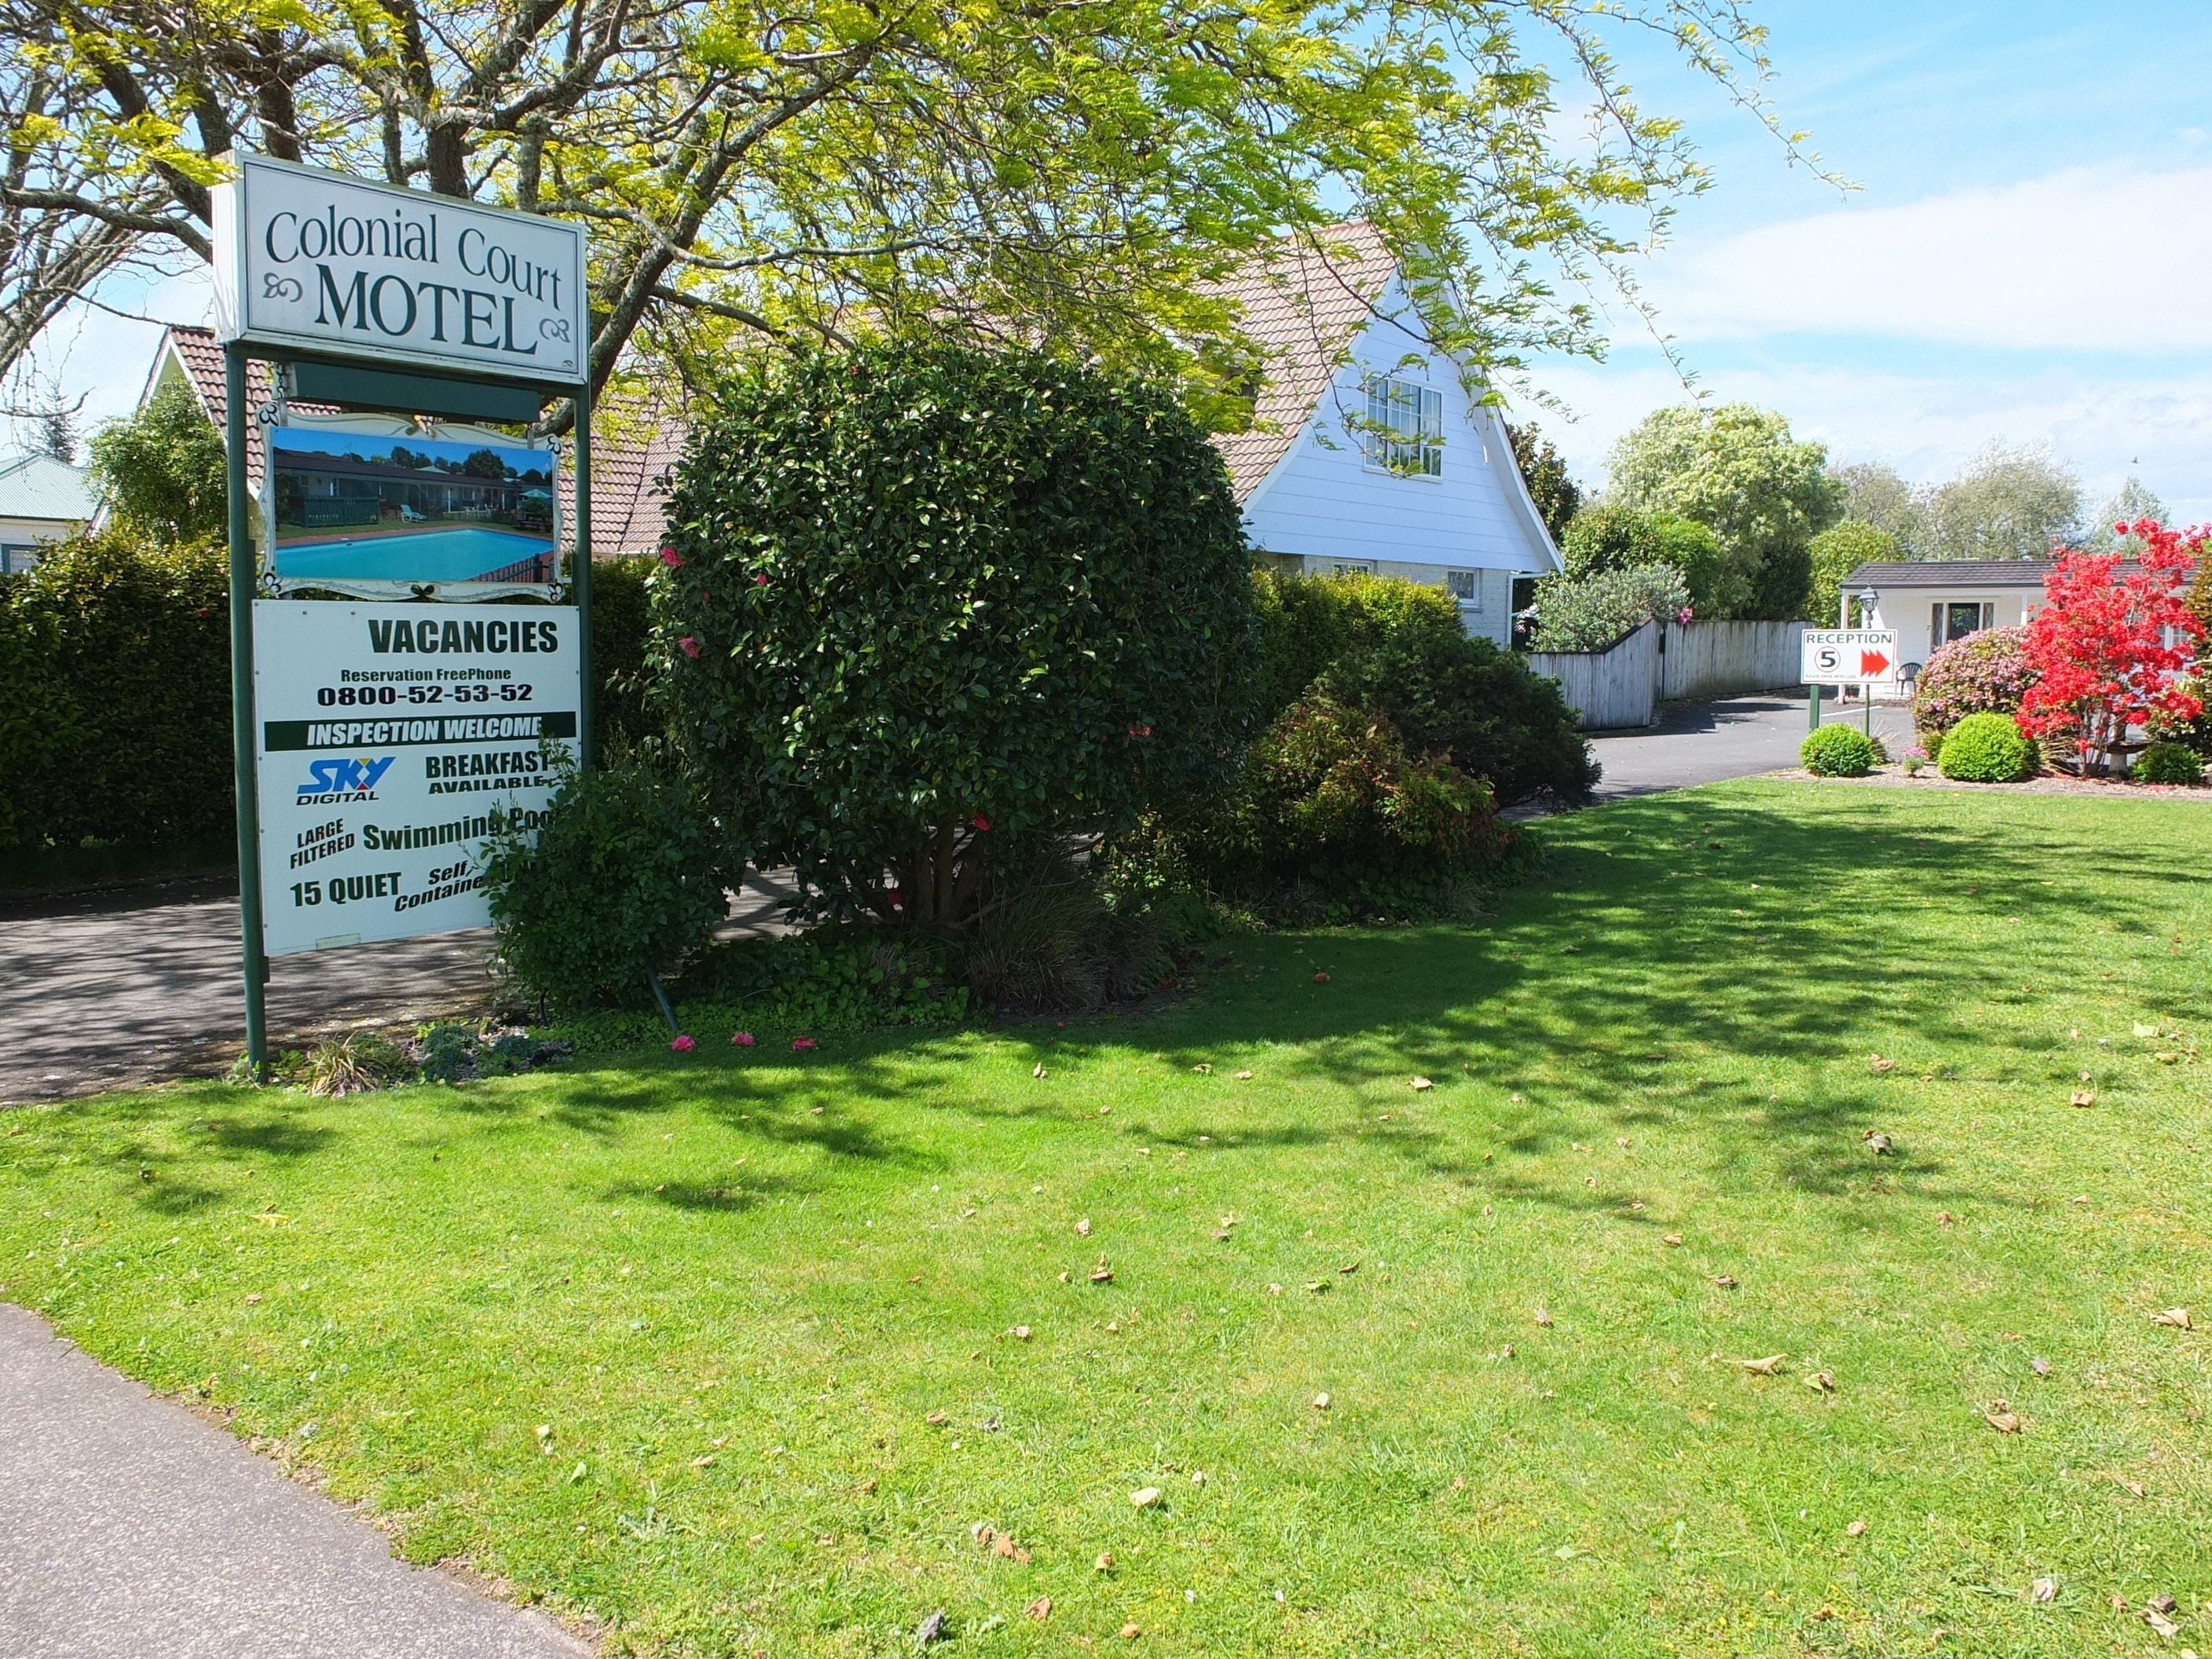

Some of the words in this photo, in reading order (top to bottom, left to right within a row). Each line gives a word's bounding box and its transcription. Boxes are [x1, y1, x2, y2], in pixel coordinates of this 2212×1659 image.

[266, 204, 438, 263] Colonial
[458, 228, 562, 311] Court
[314, 263, 539, 355] MOTEL
[368, 619, 558, 654] VACANCIES
[1806, 633, 1892, 643] RECEPTION
[1820, 650, 1836, 668] 5
[341, 668, 433, 682] Reservation
[437, 668, 511, 681] FreePhone
[317, 684, 533, 706] 0800-52-53-52
[306, 719, 440, 746] INSPECTION
[444, 716, 542, 740] WELCOME
[297, 756, 396, 794] SKY
[426, 750, 550, 778] BREAKFAST
[296, 791, 379, 806] DIGITAL
[429, 775, 544, 794] AVAILABLE
[297, 818, 345, 848] LARGE
[510, 808, 554, 831] Poo
[290, 833, 355, 870] FILTERED
[428, 859, 468, 885] Self
[291, 881, 321, 907] 15
[329, 872, 402, 905] QUIET
[394, 875, 485, 912] Containe
